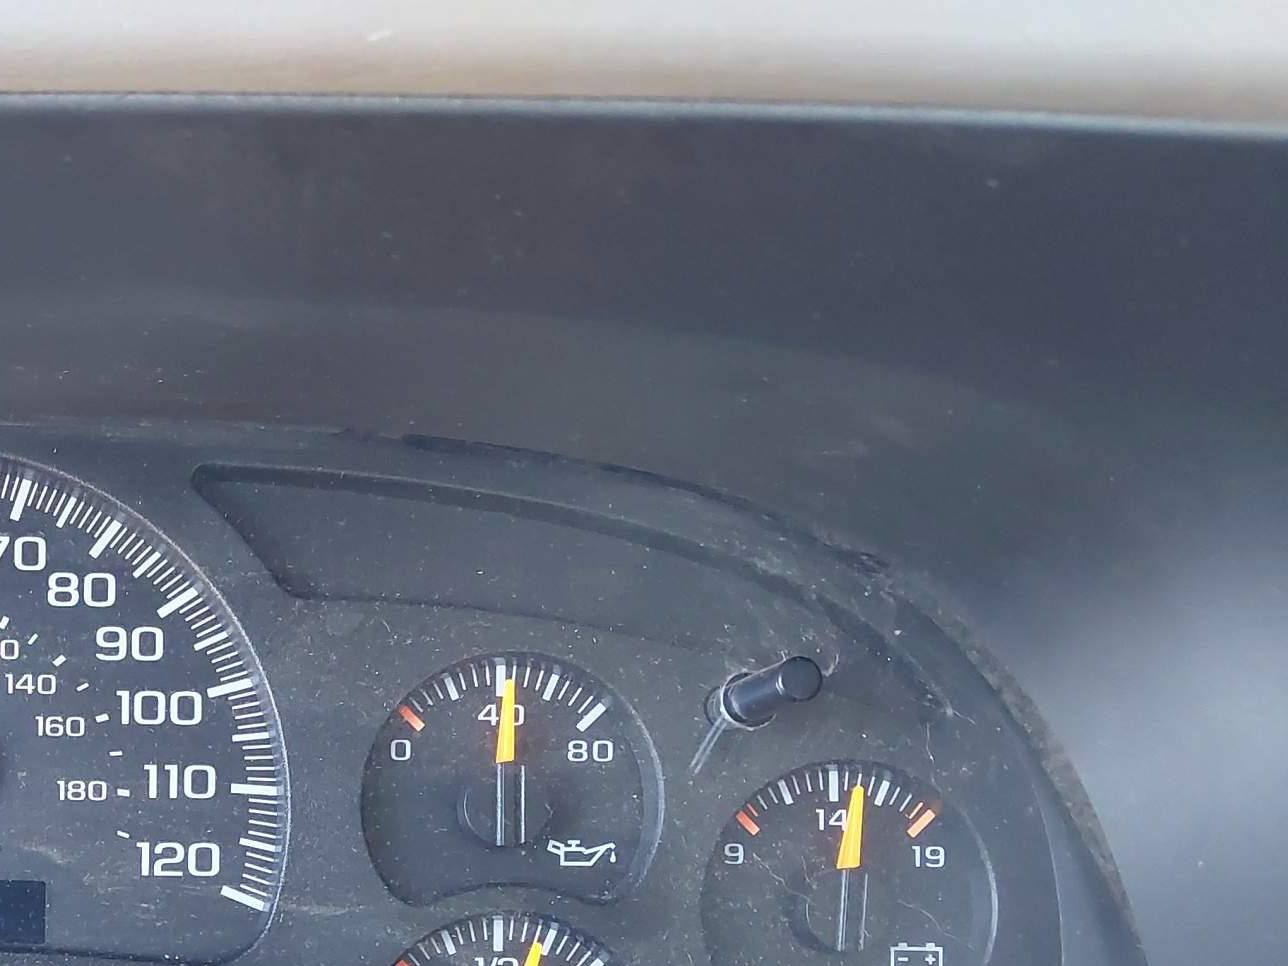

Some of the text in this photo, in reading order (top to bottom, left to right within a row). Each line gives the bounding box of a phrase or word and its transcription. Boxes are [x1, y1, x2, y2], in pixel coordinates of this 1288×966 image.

[47, 572, 116, 608] 80
[95, 626, 164, 661] 90
[5, 673, 57, 695] 140
[116, 690, 203, 726] 100
[35, 715, 85, 737] 160
[390, 739, 411, 761] 0
[567, 739, 614, 762] 80
[56, 780, 107, 802] 180
[143, 764, 216, 799] 110
[815, 808, 848, 832] 14
[136, 841, 220, 877] 120
[724, 843, 744, 865] 9
[911, 845, 945, 868] 19
